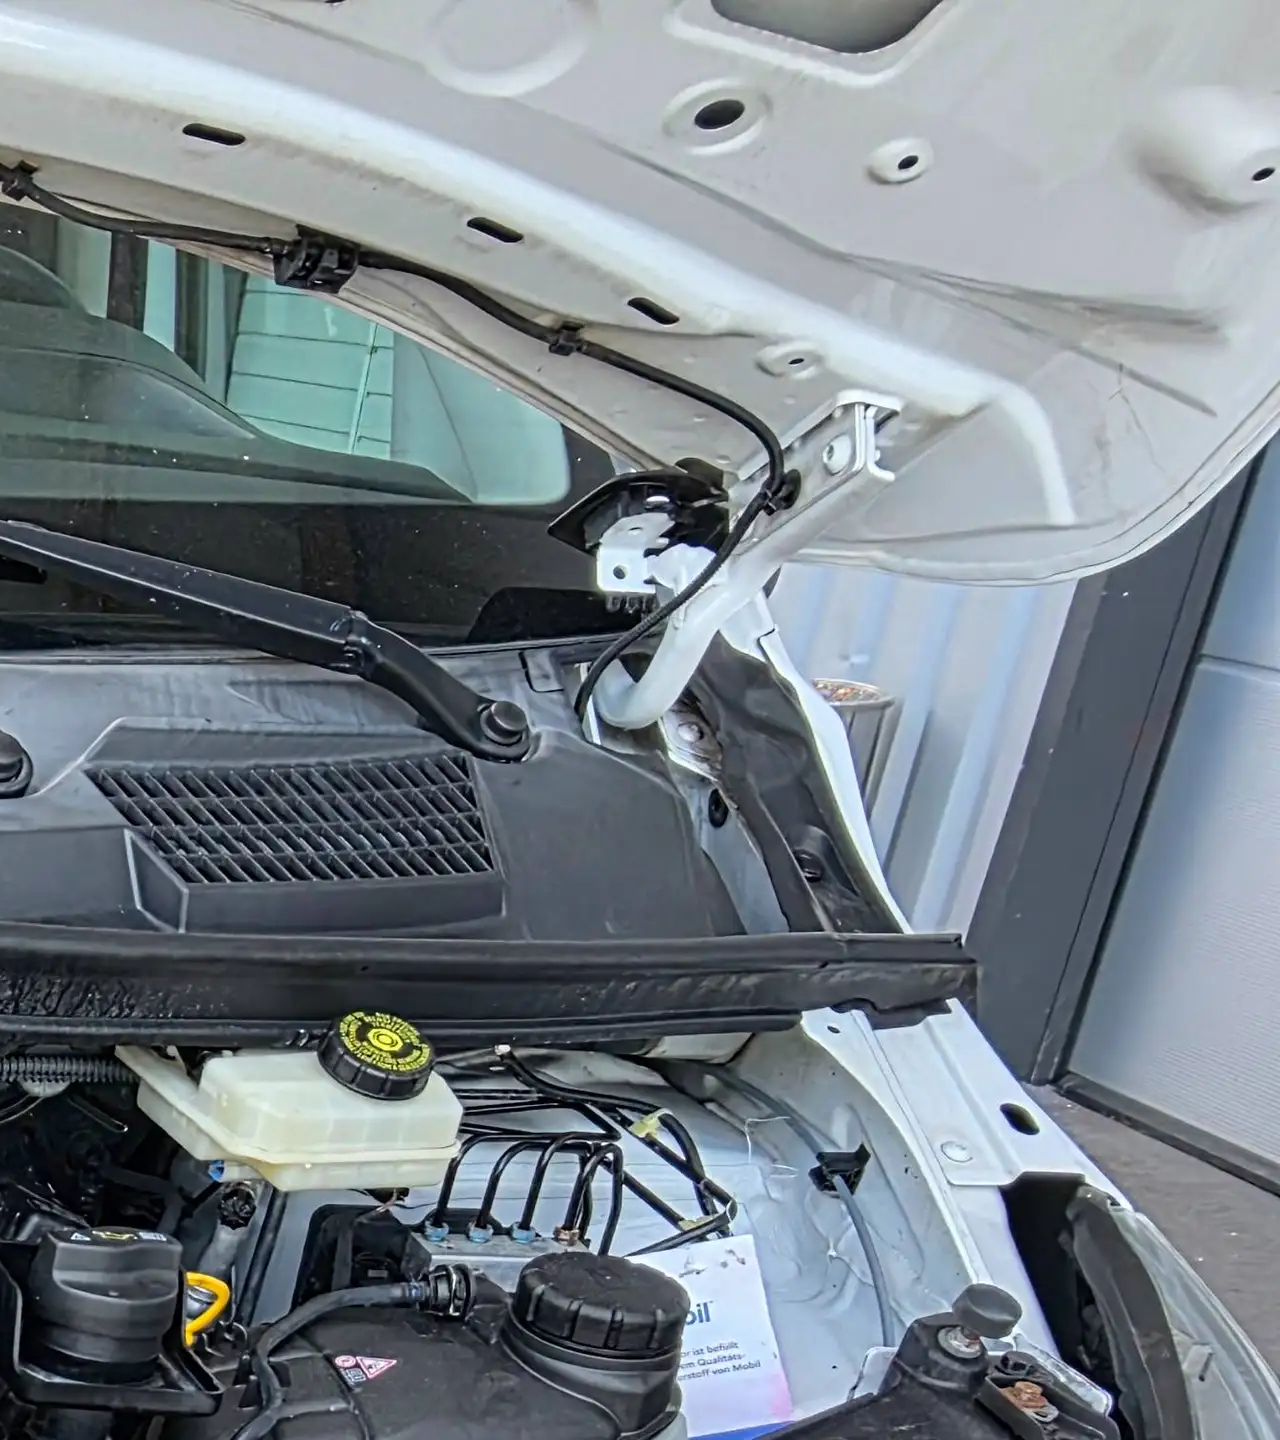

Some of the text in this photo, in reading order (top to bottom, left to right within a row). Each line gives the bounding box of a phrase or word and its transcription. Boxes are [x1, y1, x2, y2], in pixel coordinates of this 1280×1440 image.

[692, 1348, 705, 1356] ist
[677, 1359, 761, 1380] erstoff von Mobil
